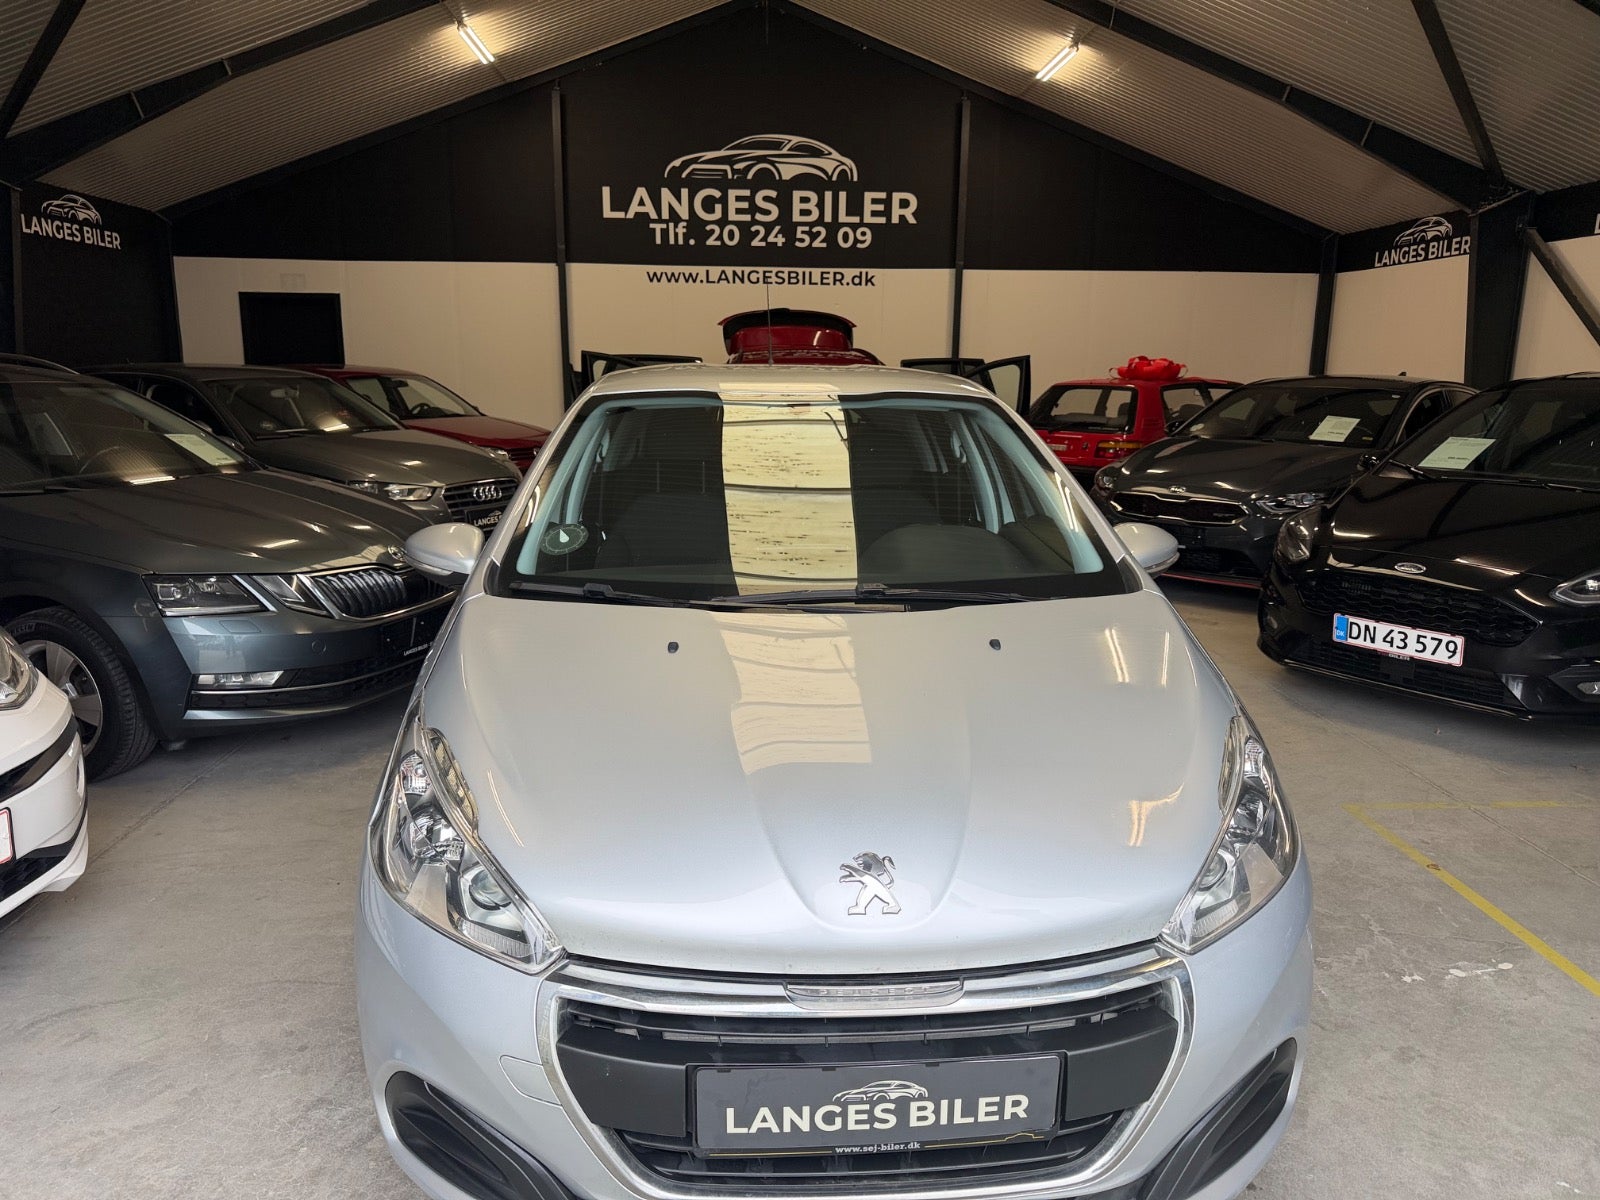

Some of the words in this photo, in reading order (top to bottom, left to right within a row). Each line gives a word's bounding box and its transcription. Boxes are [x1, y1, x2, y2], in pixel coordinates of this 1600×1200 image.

[602, 186, 780, 221] LANGES
[792, 190, 918, 224] BILER
[21, 213, 81, 242] LANGES
[83, 226, 121, 250] BILER
[649, 221, 696, 245] Tlf.
[705, 224, 740, 246] 20
[750, 225, 786, 247] 24
[795, 226, 827, 248] 52
[837, 227, 873, 249] 09
[1374, 244, 1426, 268] LANGES
[1428, 235, 1470, 260] BILER
[646, 269, 876, 287] www.LANGESBILER.dk
[1336, 629, 1345, 637] DK
[1348, 621, 1377, 644] DN
[1382, 629, 1409, 650] 43
[1414, 634, 1458, 660] 579
[725, 1102, 897, 1134] LANGES
[909, 1094, 1029, 1128] BILER
[835, 1141, 921, 1156] www.sej-biler.dk
